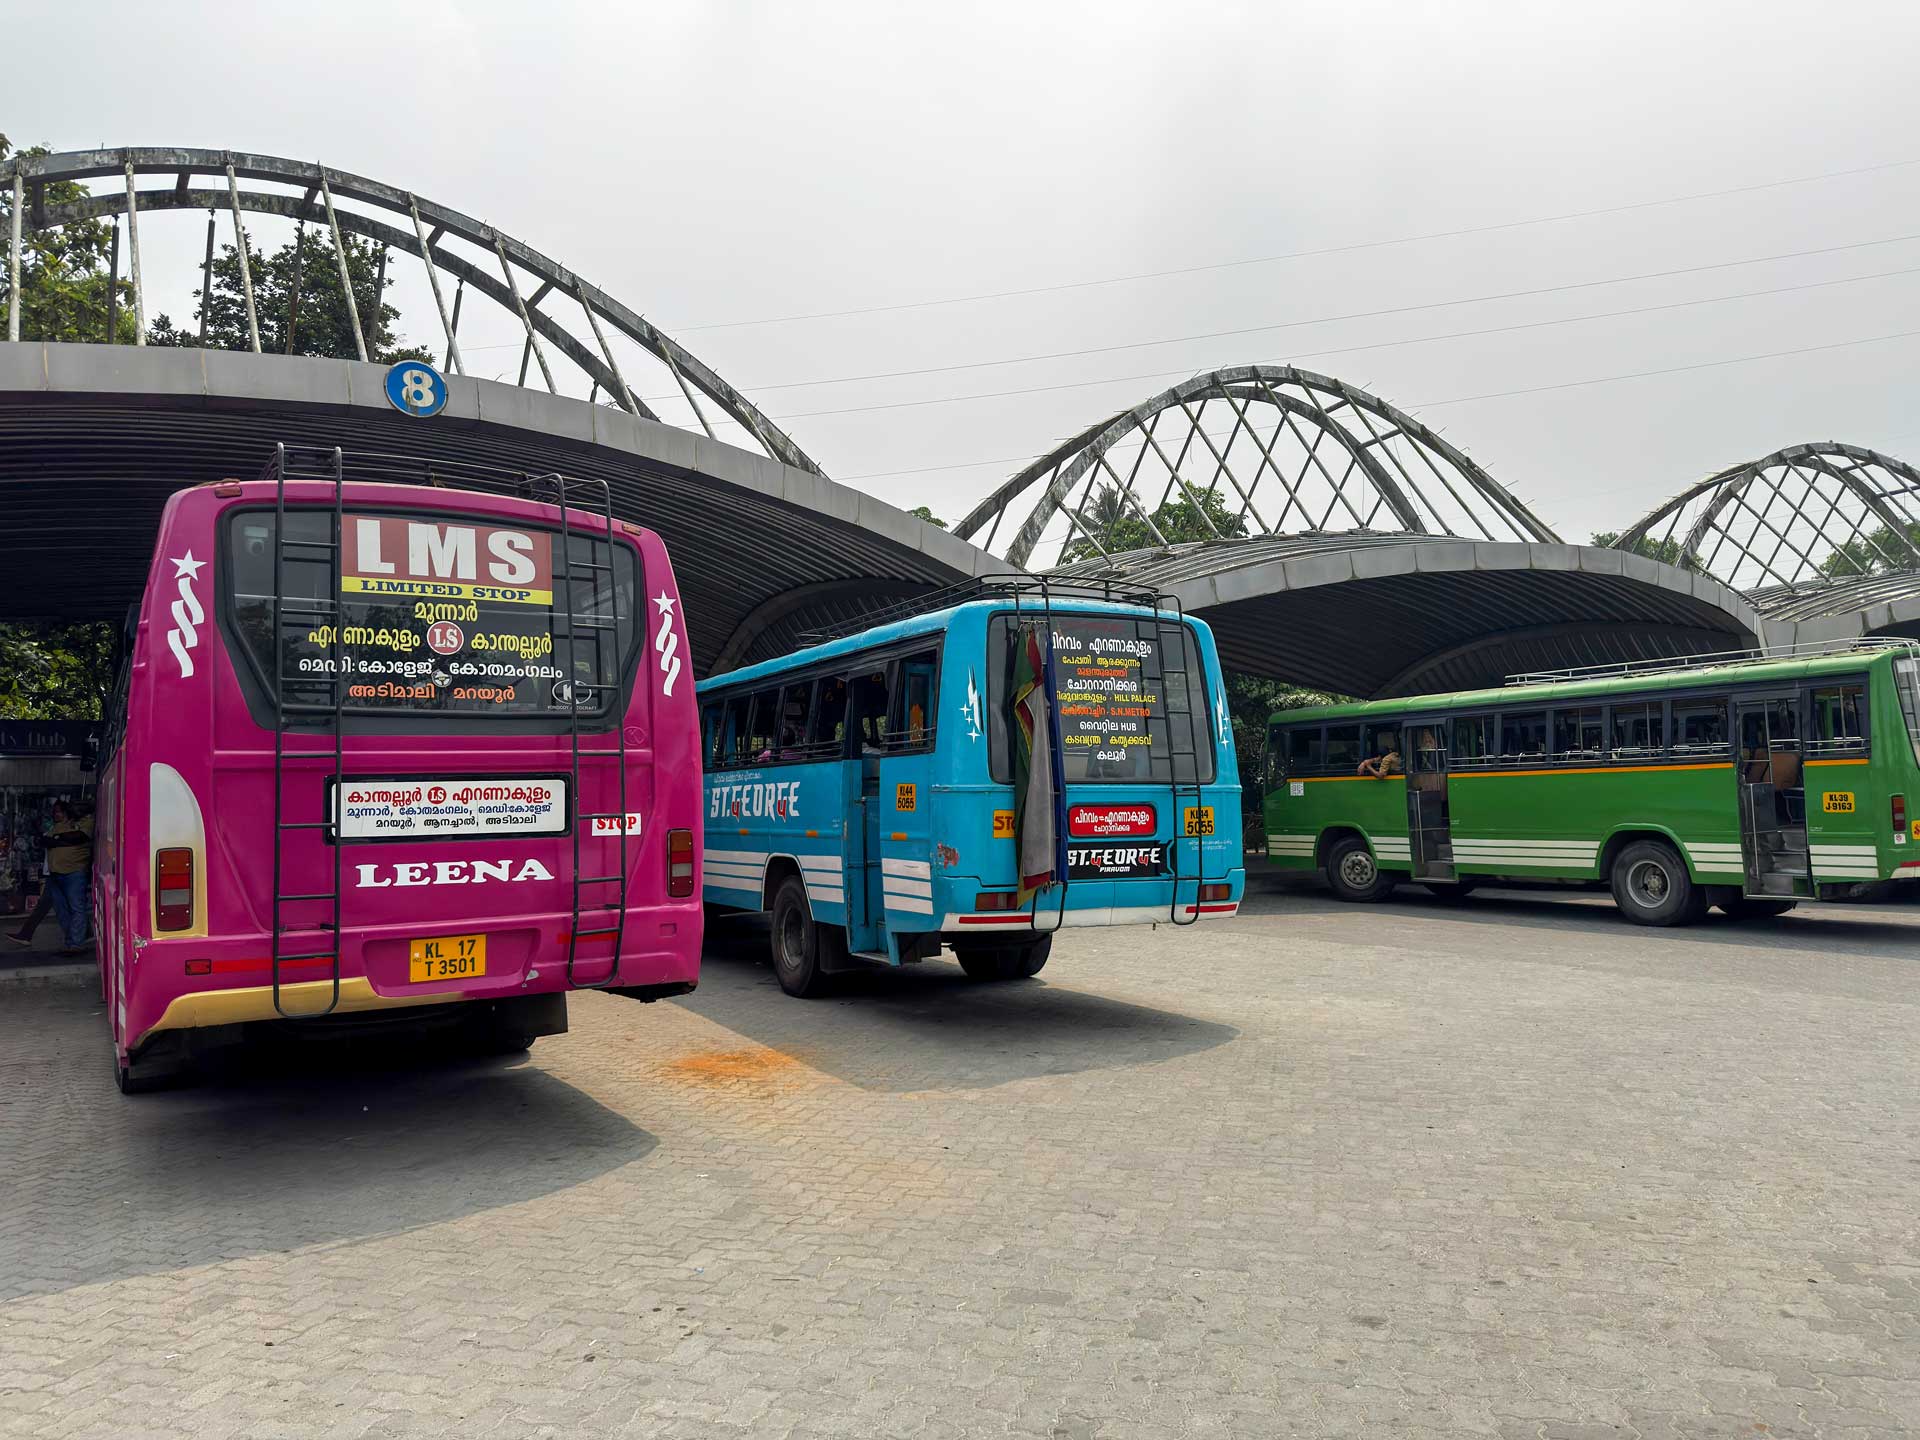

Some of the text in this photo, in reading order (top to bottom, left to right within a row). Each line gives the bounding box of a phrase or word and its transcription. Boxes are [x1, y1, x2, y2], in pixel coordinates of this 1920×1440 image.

[402, 369, 434, 407] 8
[356, 519, 536, 584] LMS
[360, 580, 531, 601] LIMITED STOP
[414, 600, 478, 625] മൂന്നാർ
[433, 629, 458, 649] LS
[470, 632, 553, 660] കാന്തല്ലൂർ
[1089, 637, 1152, 658] എറണാകുളം
[449, 661, 564, 680] കോതമംഗലം
[348, 682, 516, 704] അടിമാലി മറയൂർ
[1114, 694, 1157, 703] HILL PALACE
[1120, 722, 1137, 732] HUB
[347, 787, 422, 807] കാന്തല്ലൂർ
[430, 789, 444, 801] LS
[452, 787, 551, 805] എറണാകുളം
[485, 814, 537, 825] അടിമാലി
[1186, 820, 1214, 835] 5055
[355, 859, 556, 888] LEENA
[425, 939, 477, 959] KL 17
[425, 957, 476, 977] T 3501
